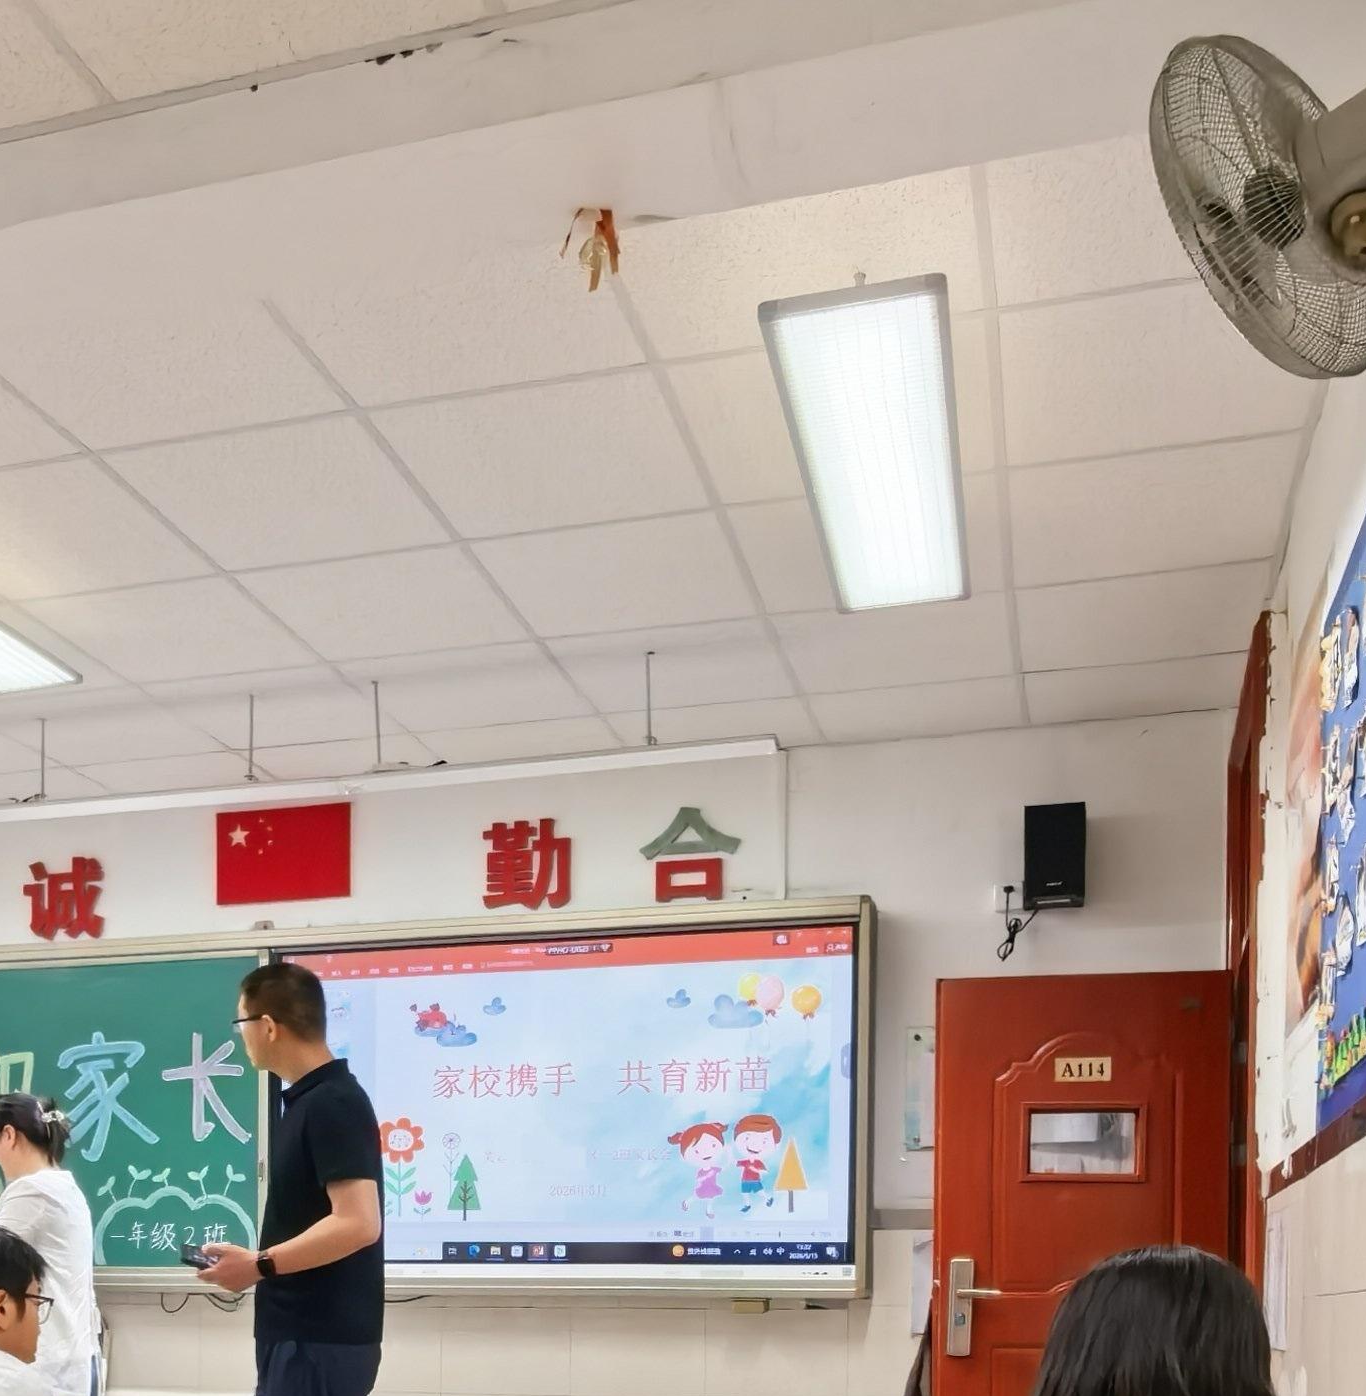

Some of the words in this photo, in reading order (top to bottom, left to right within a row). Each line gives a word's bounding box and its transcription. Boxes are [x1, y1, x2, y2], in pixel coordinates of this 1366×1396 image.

[432, 1062, 577, 1099] 家校携手
[616, 1055, 771, 1096] 共育新苗
[1061, 1062, 1105, 1079] A114
[110, 1220, 232, 1252] 一年级2班
